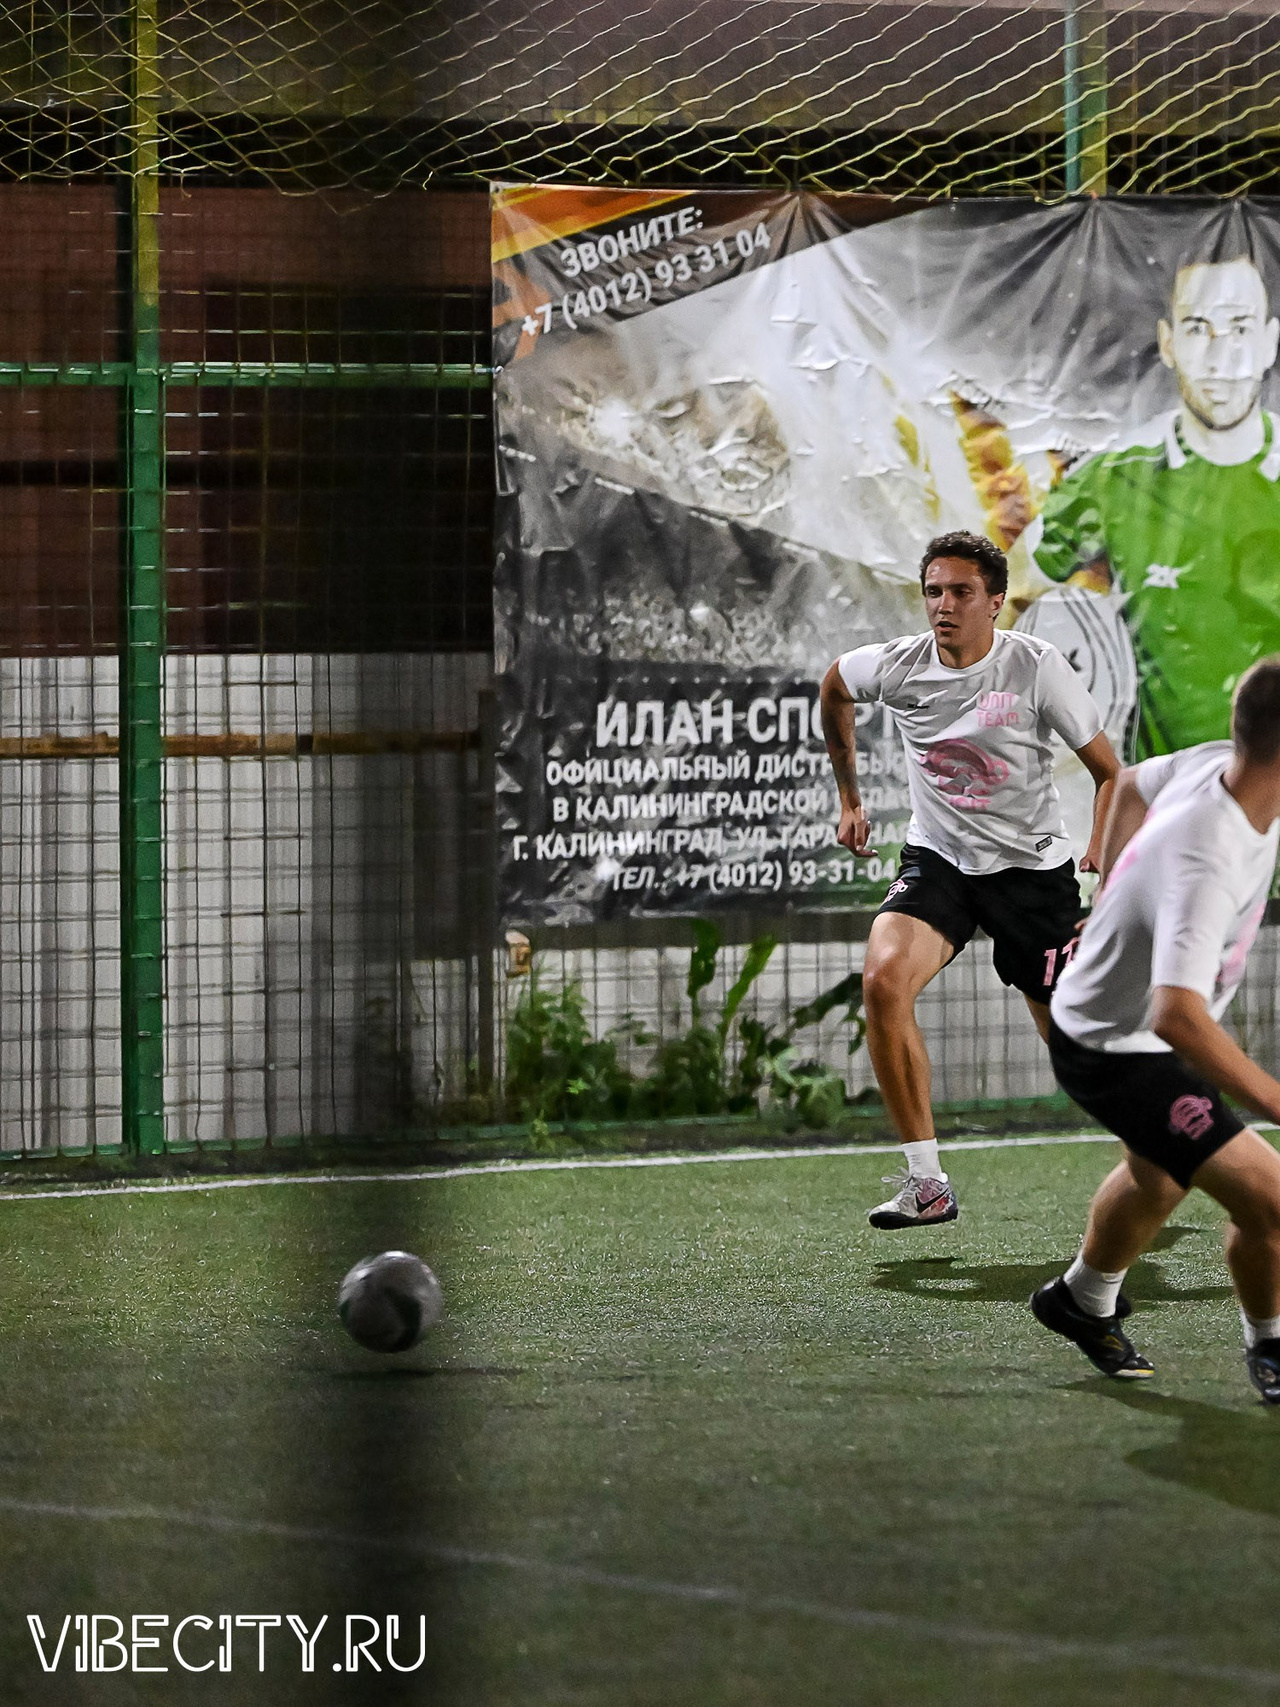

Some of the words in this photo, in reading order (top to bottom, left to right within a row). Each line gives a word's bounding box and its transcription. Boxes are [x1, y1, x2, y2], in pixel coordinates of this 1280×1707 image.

[560, 205, 703, 278] ЗВОНИТЕ:
[521, 302, 553, 336] +7
[562, 266, 652, 330] (4012)
[655, 252, 693, 288] 93
[695, 239, 730, 273] 31
[736, 221, 771, 258] 04
[545, 749, 750, 788] ОФИЦИАЛЬНЫЙ
[553, 797, 570, 822] В
[576, 784, 829, 824] КАЛИНИНГРАДСКОЙ
[709, 860, 783, 894] (4012)
[788, 857, 897, 887] 93-31-04
